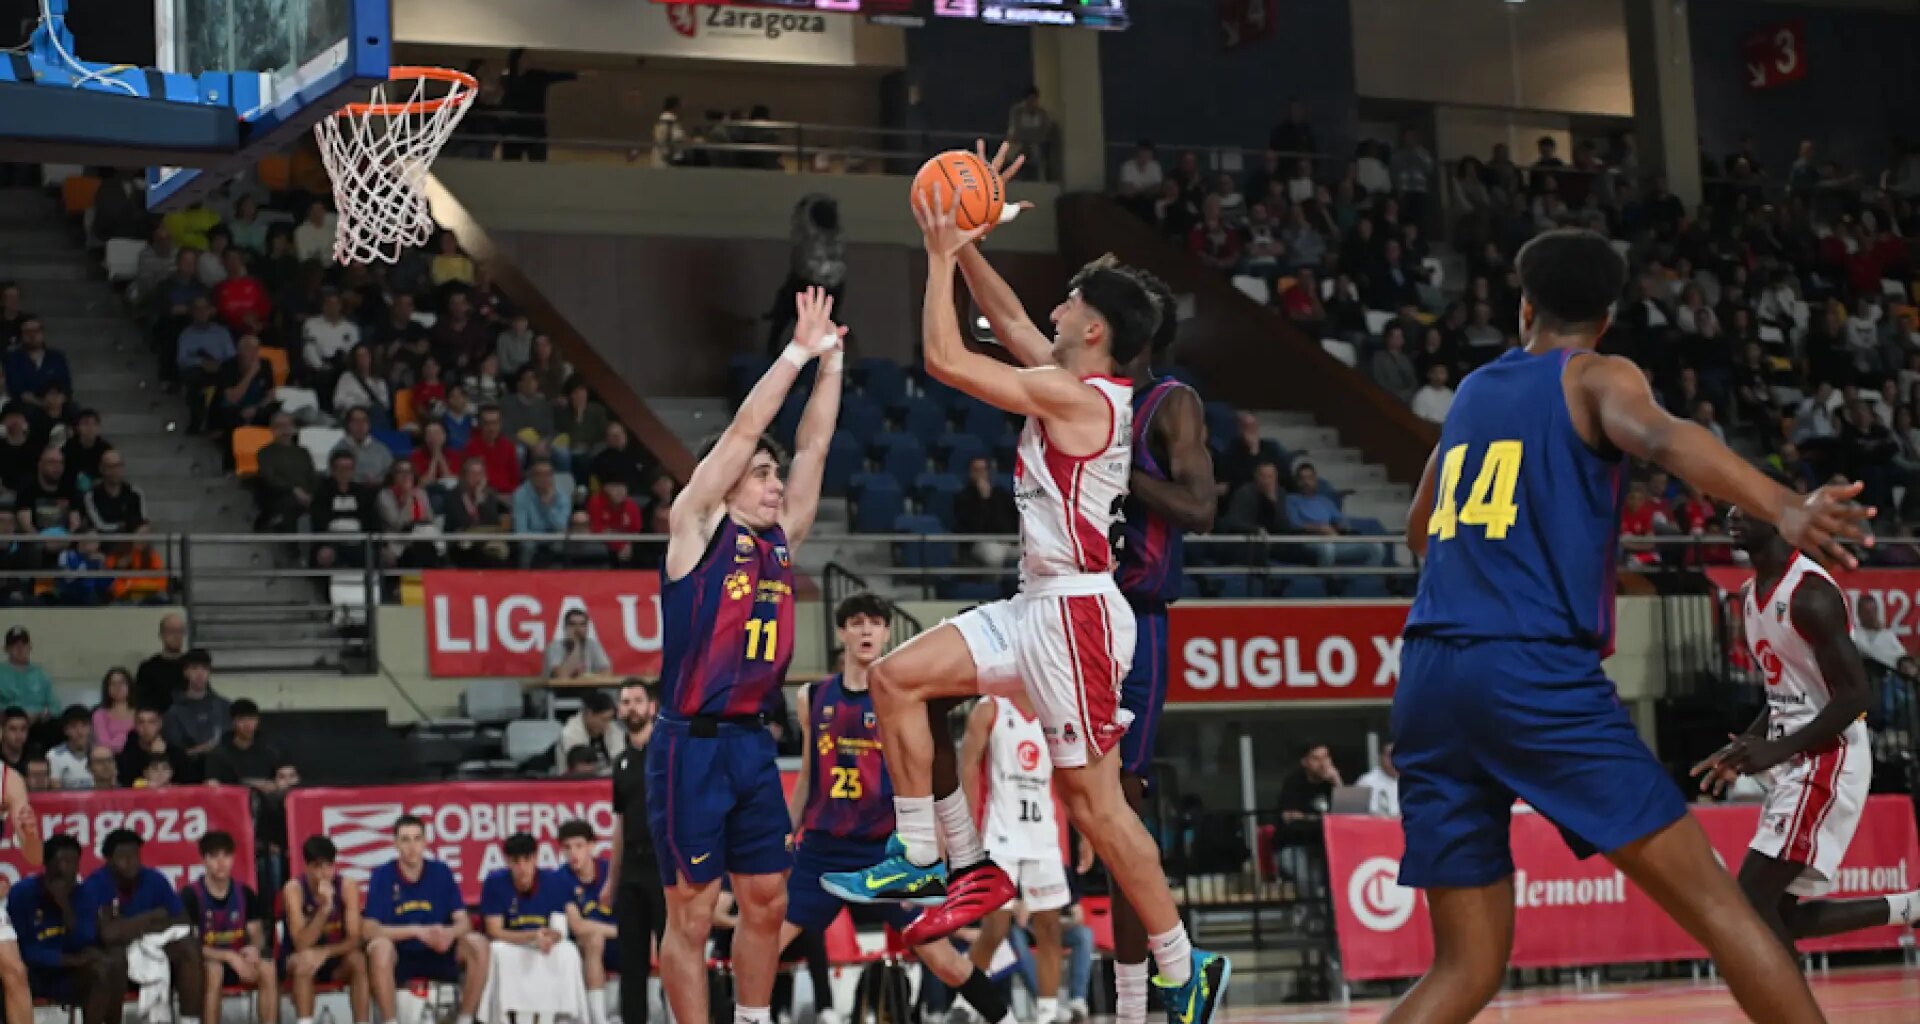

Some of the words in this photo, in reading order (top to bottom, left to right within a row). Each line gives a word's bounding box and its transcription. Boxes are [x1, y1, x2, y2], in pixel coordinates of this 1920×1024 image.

[706, 5, 826, 39] Zaragoza
[1774, 28, 1798, 75] 3
[1427, 440, 1524, 541] 44
[433, 595, 604, 653] LIGA
[744, 618, 778, 662] 11
[1183, 635, 1357, 689] SIGLO
[830, 765, 863, 799] 23
[1018, 799, 1043, 822] 10
